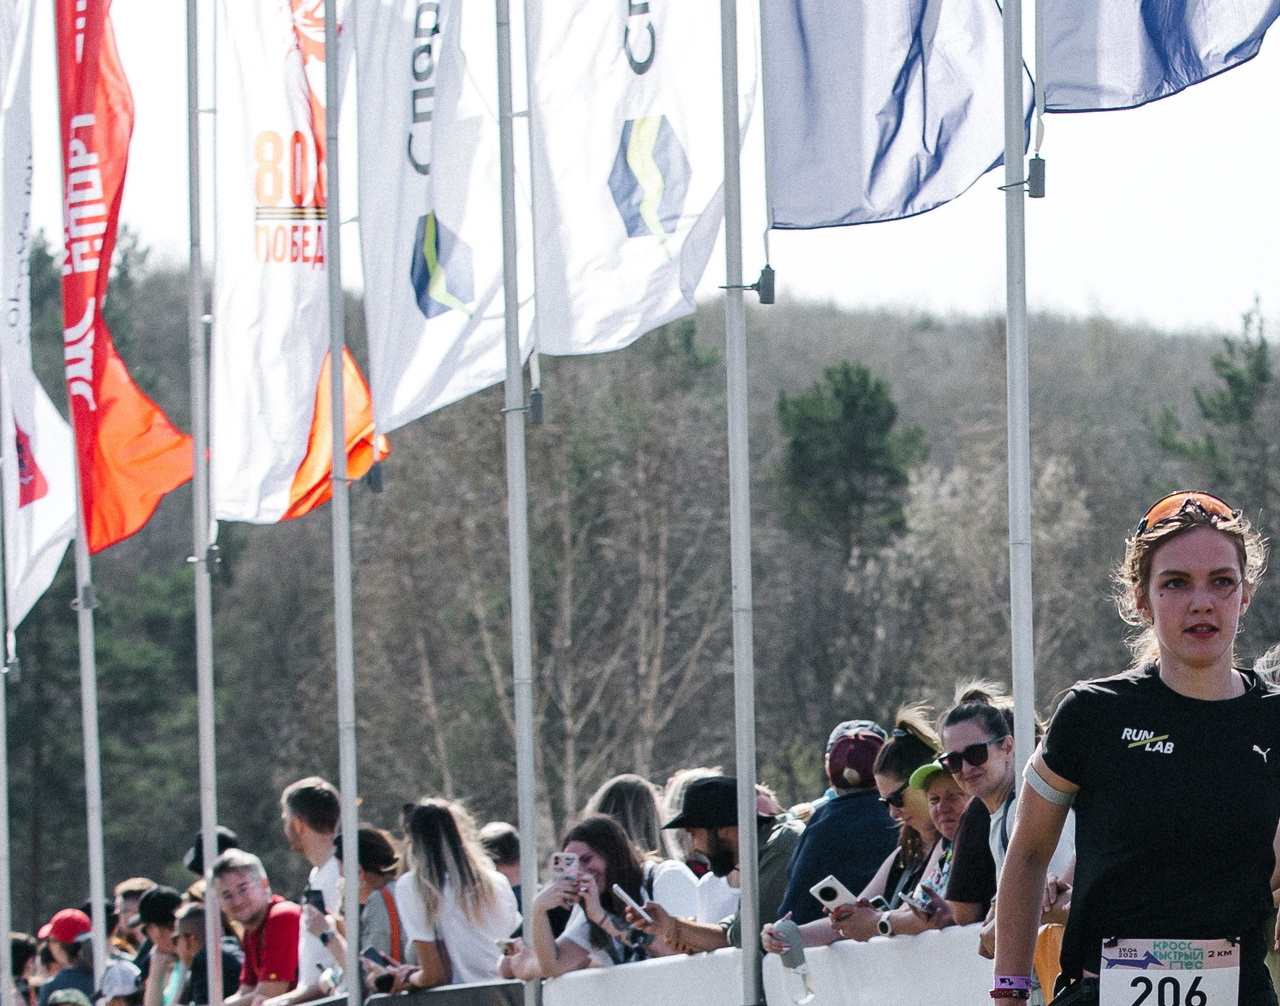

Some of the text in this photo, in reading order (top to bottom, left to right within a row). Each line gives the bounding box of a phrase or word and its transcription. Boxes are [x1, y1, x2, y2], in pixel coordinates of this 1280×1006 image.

[254, 130, 309, 207] 80
[255, 225, 326, 271] ПОБЕД
[1121, 727, 1155, 741] RUN
[1144, 741, 1175, 754] LAB
[1153, 941, 1203, 951] КРОСС
[1208, 950, 1215, 958] 2
